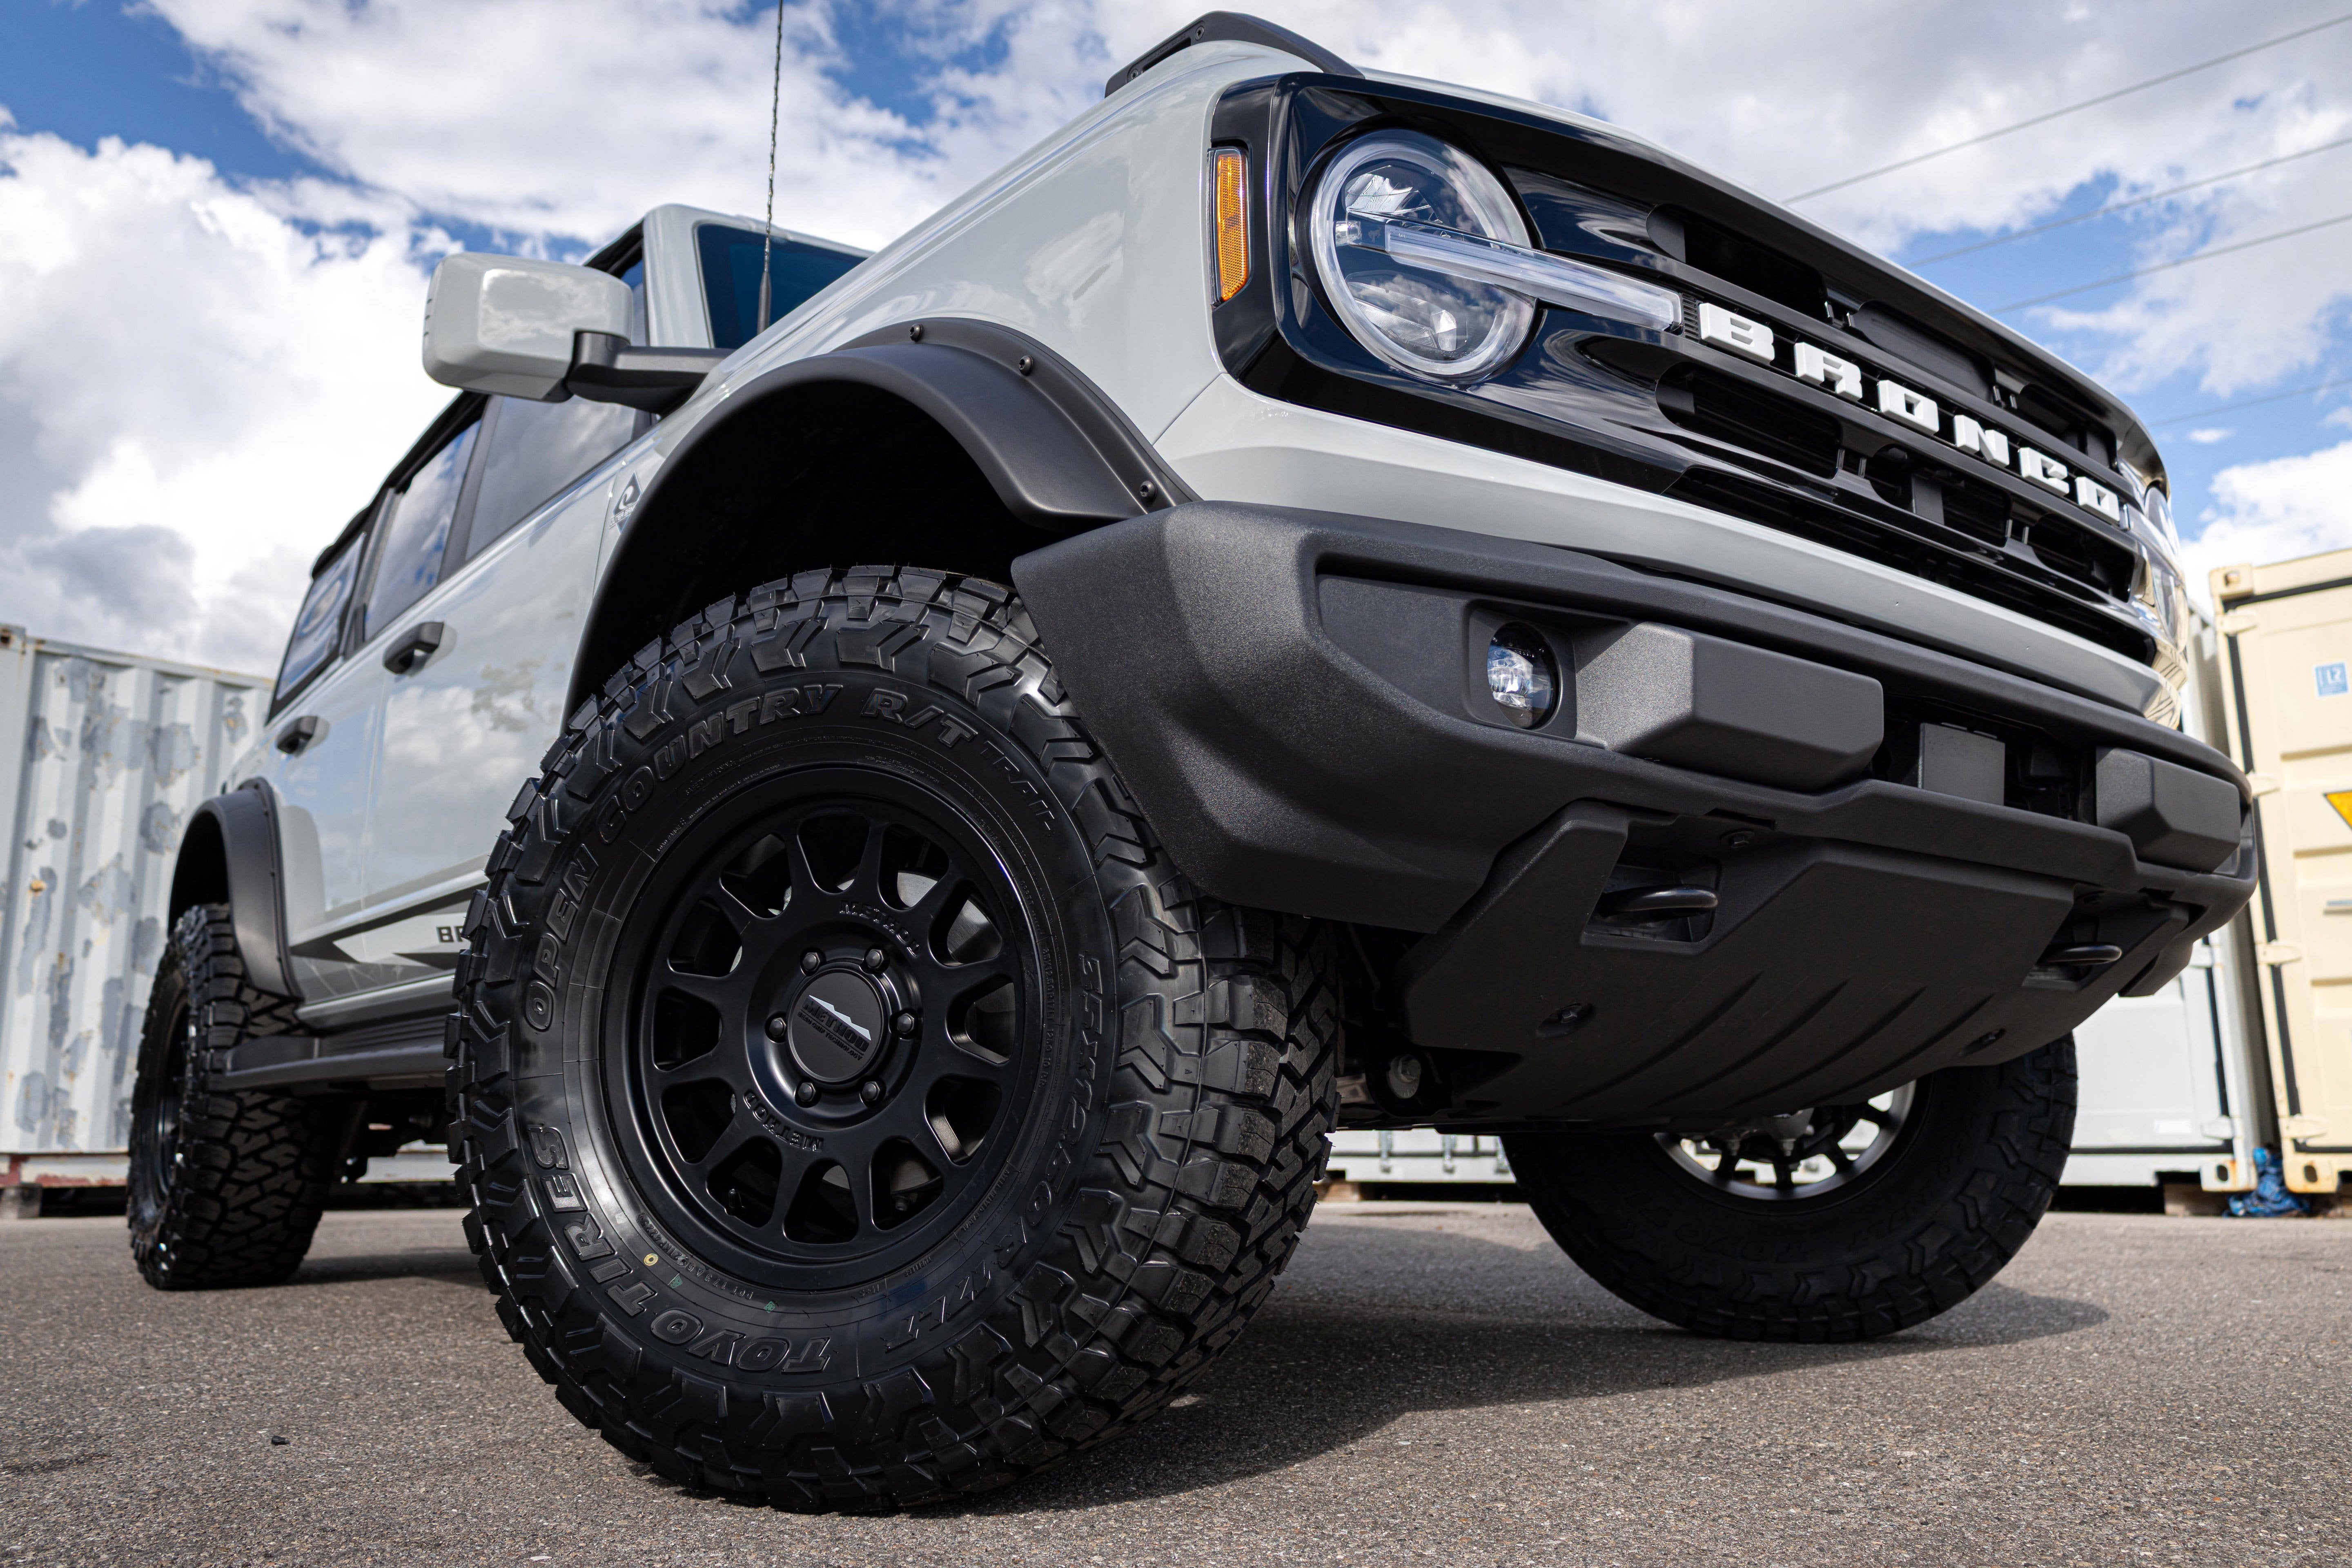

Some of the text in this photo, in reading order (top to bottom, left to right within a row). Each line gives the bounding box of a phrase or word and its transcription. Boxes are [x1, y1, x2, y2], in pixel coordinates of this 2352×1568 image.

[1699, 302, 2120, 525] BRONCO
[525, 842, 599, 1031] OPEN
[595, 684, 844, 845] COUNTRY
[860, 688, 978, 748] R/T
[980, 740, 1055, 831] TRAIL
[839, 900, 922, 958] METHOD
[797, 1011, 863, 1061] BEAD GRIP TECHNOLOGY
[802, 998, 870, 1052] METHOD
[743, 1089, 824, 1152] METHOD
[526, 1124, 831, 1374] TOYO TIRES
[731, 1286, 754, 1300] DOT
